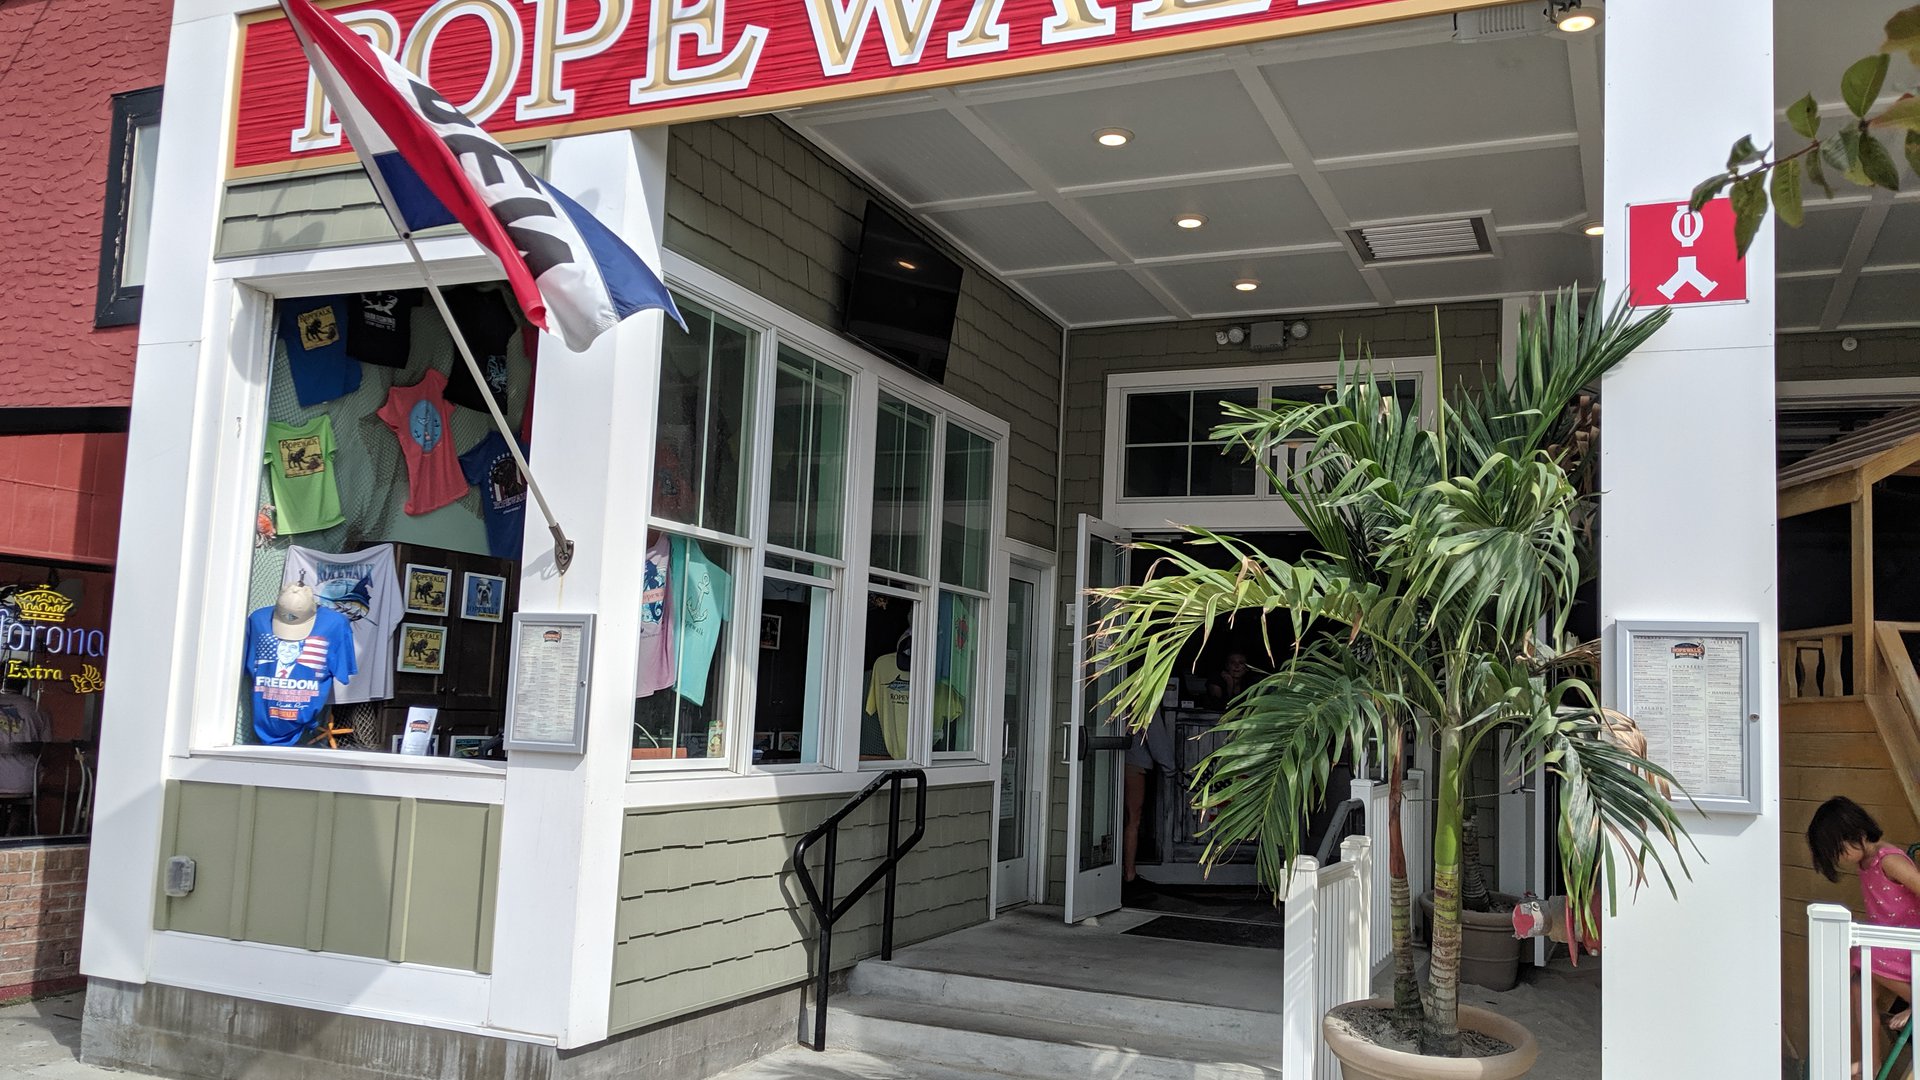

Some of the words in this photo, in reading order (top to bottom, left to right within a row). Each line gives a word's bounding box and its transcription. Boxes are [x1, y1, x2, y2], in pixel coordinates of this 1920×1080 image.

[407, 78, 575, 280] PEN
[8, 660, 63, 680] Extra
[255, 676, 319, 691] FREEDOM
